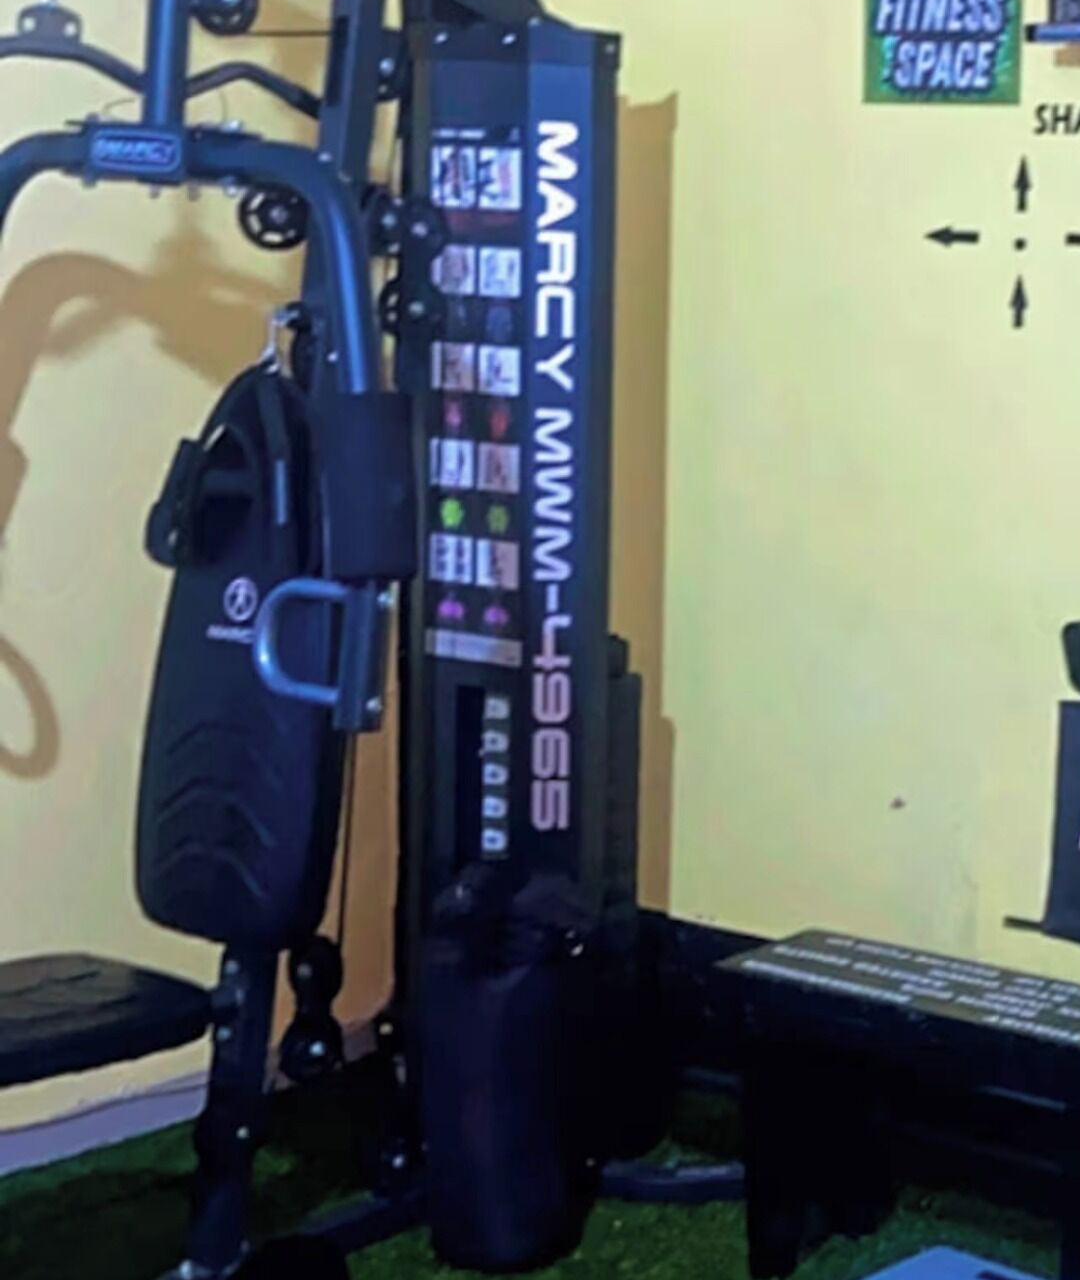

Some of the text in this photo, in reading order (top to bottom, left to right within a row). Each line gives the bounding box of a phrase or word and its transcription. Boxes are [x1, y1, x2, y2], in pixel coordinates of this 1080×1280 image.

[893, 41, 996, 89] SPACE
[530, 121, 579, 831] MARCY MWM-4965
